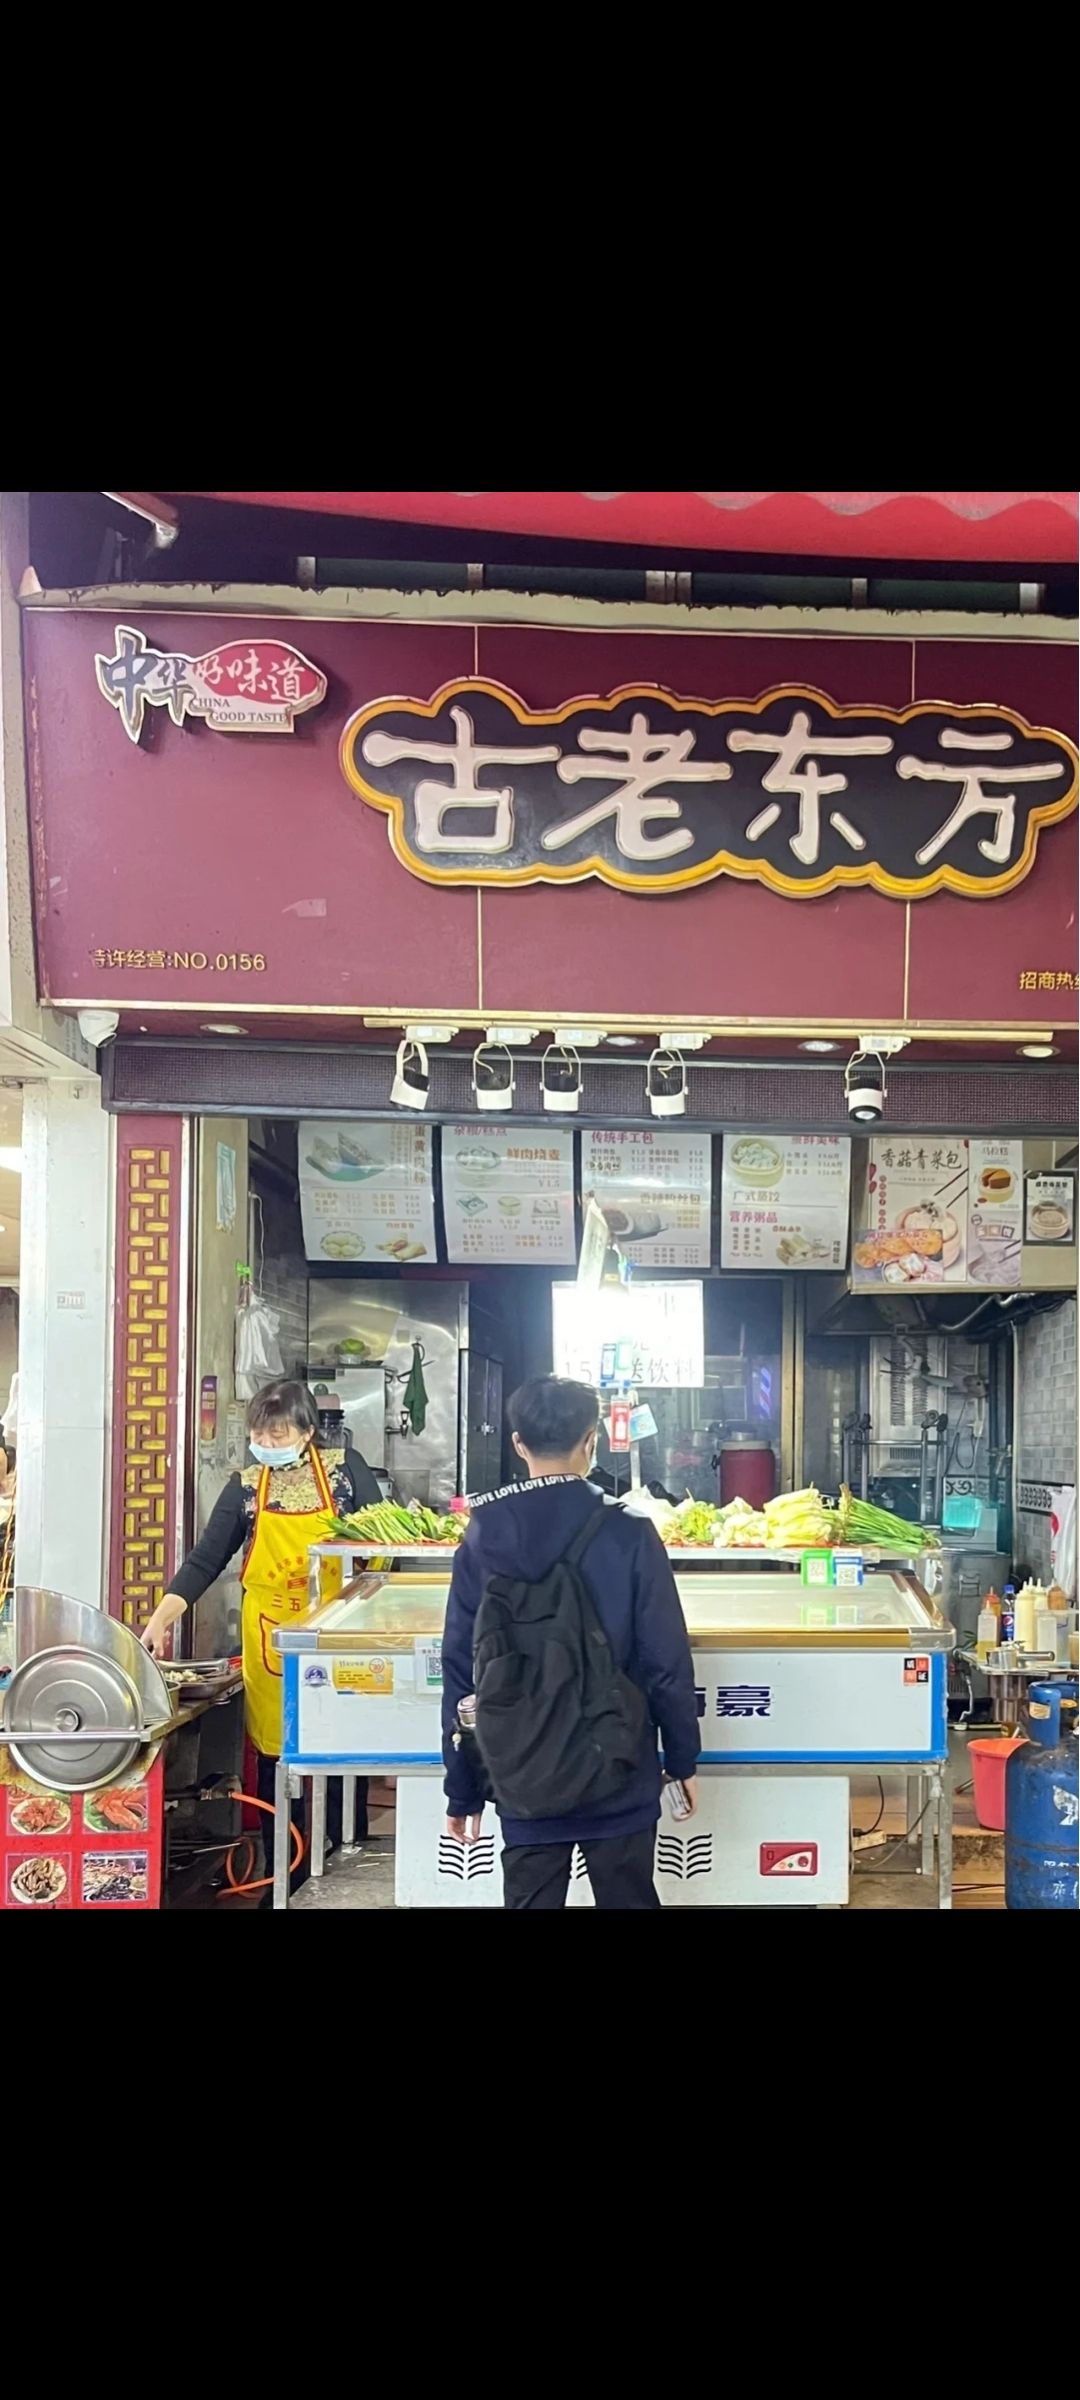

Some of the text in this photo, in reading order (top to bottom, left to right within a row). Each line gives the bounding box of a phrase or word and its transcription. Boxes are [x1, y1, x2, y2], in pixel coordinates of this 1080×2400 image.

[104, 637, 305, 721] 中华好味道
[363, 705, 1064, 864] 古老东方
[592, 1130, 654, 1144] 传统手工包
[881, 1148, 962, 1170] 香菇青菜包
[730, 1211, 778, 1223] 营养粥品
[494, 1483, 520, 1499] LOVE
[519, 1479, 545, 1492] LOVE
